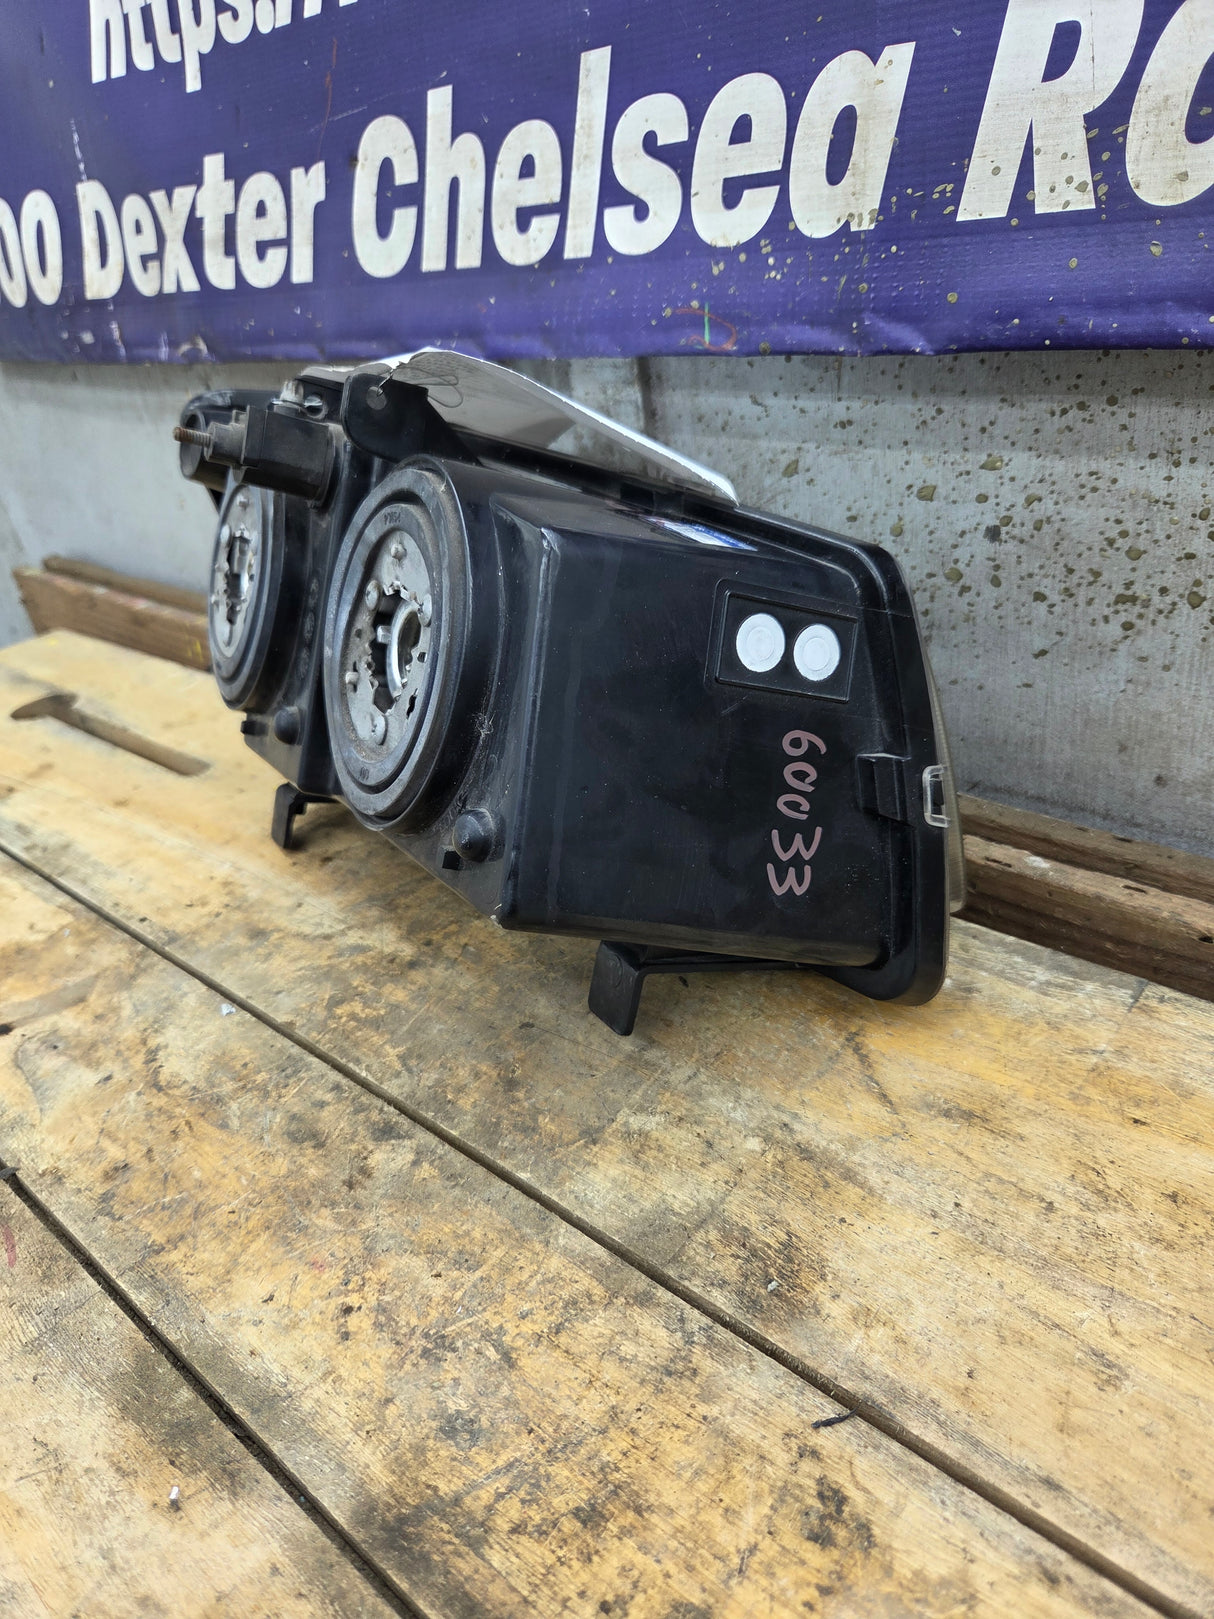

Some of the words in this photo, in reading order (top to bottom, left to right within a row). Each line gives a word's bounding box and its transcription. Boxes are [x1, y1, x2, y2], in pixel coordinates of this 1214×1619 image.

[75, 153, 326, 300] Dexter
[351, 41, 917, 279] Chelsea
[766, 729, 827, 896] 60033
